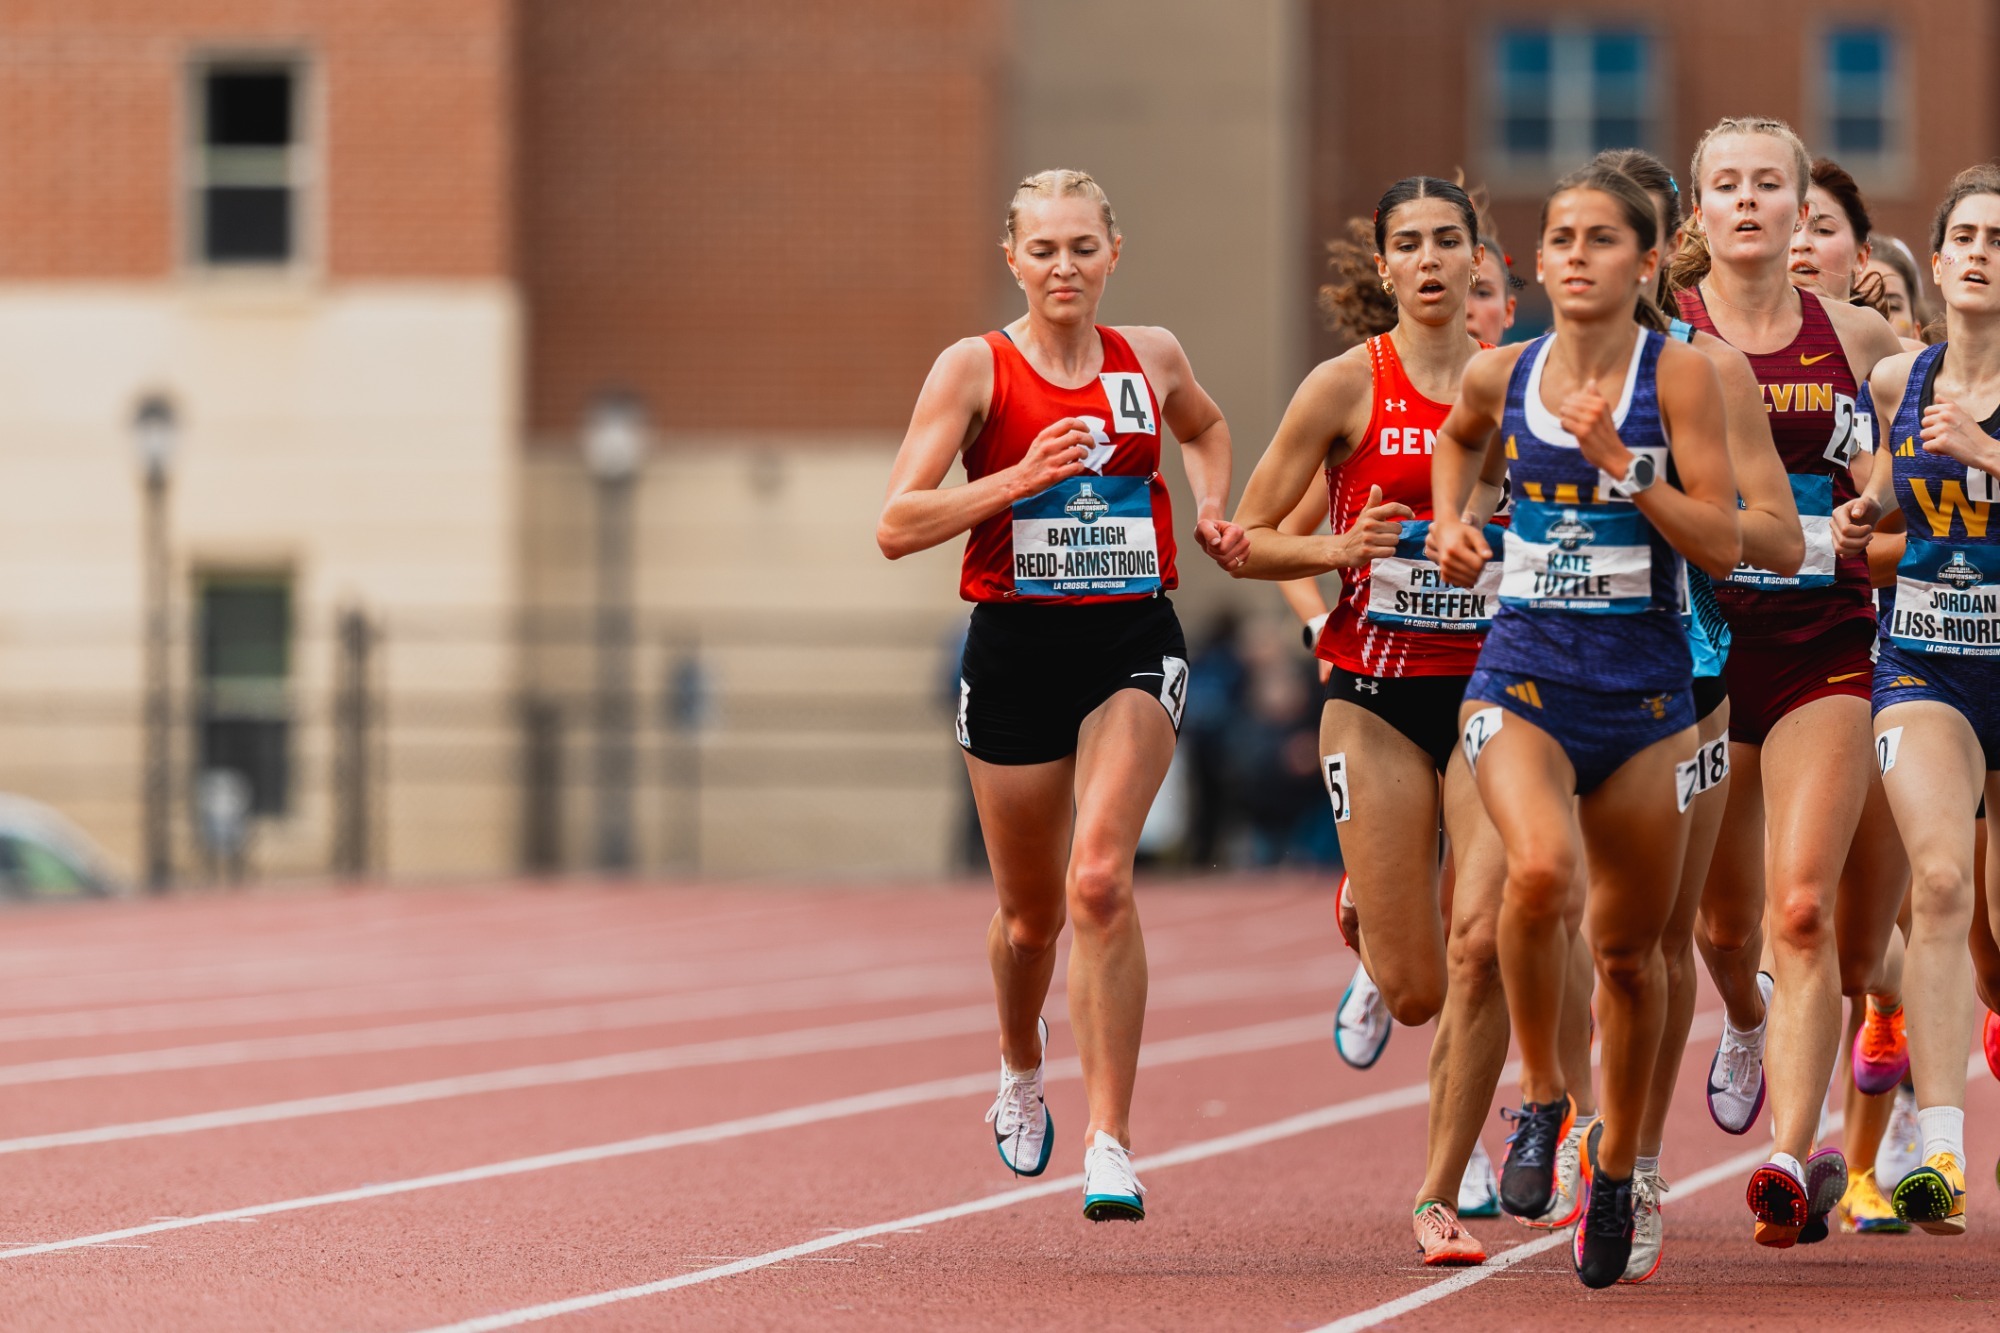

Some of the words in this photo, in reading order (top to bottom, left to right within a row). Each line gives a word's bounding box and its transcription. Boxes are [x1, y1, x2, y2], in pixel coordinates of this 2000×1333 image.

[1120, 379, 1147, 429] 4
[1834, 403, 1853, 462] 2
[1908, 478, 1990, 537] W
[1048, 526, 1127, 547] BAYLEIGH
[1016, 550, 1157, 578] REDD-ARMSTRONG
[1548, 552, 1593, 573] KATE
[1053, 582, 1063, 590] LA
[1063, 581, 1090, 590] CROSSE,
[1091, 580, 1126, 589] WISCONSIN
[1534, 571, 1612, 597] TUTTLE
[1734, 575, 1762, 585] CROSSE,
[1763, 576, 1800, 585] WISCONSIN
[1395, 590, 1486, 618] STEFFEN
[1930, 591, 1997, 613] JORDAN
[1404, 618, 1413, 626] LA
[1413, 619, 1439, 629] CROSSE,
[1441, 622, 1477, 630] WISCONSIN
[1925, 644, 1935, 652] LA
[1935, 646, 1961, 655] CROSSE,
[1963, 648, 2000, 656] WISCONSIN
[1168, 667, 1187, 717] 4
[1698, 741, 1725, 789] 18
[1328, 762, 1344, 820] 5
